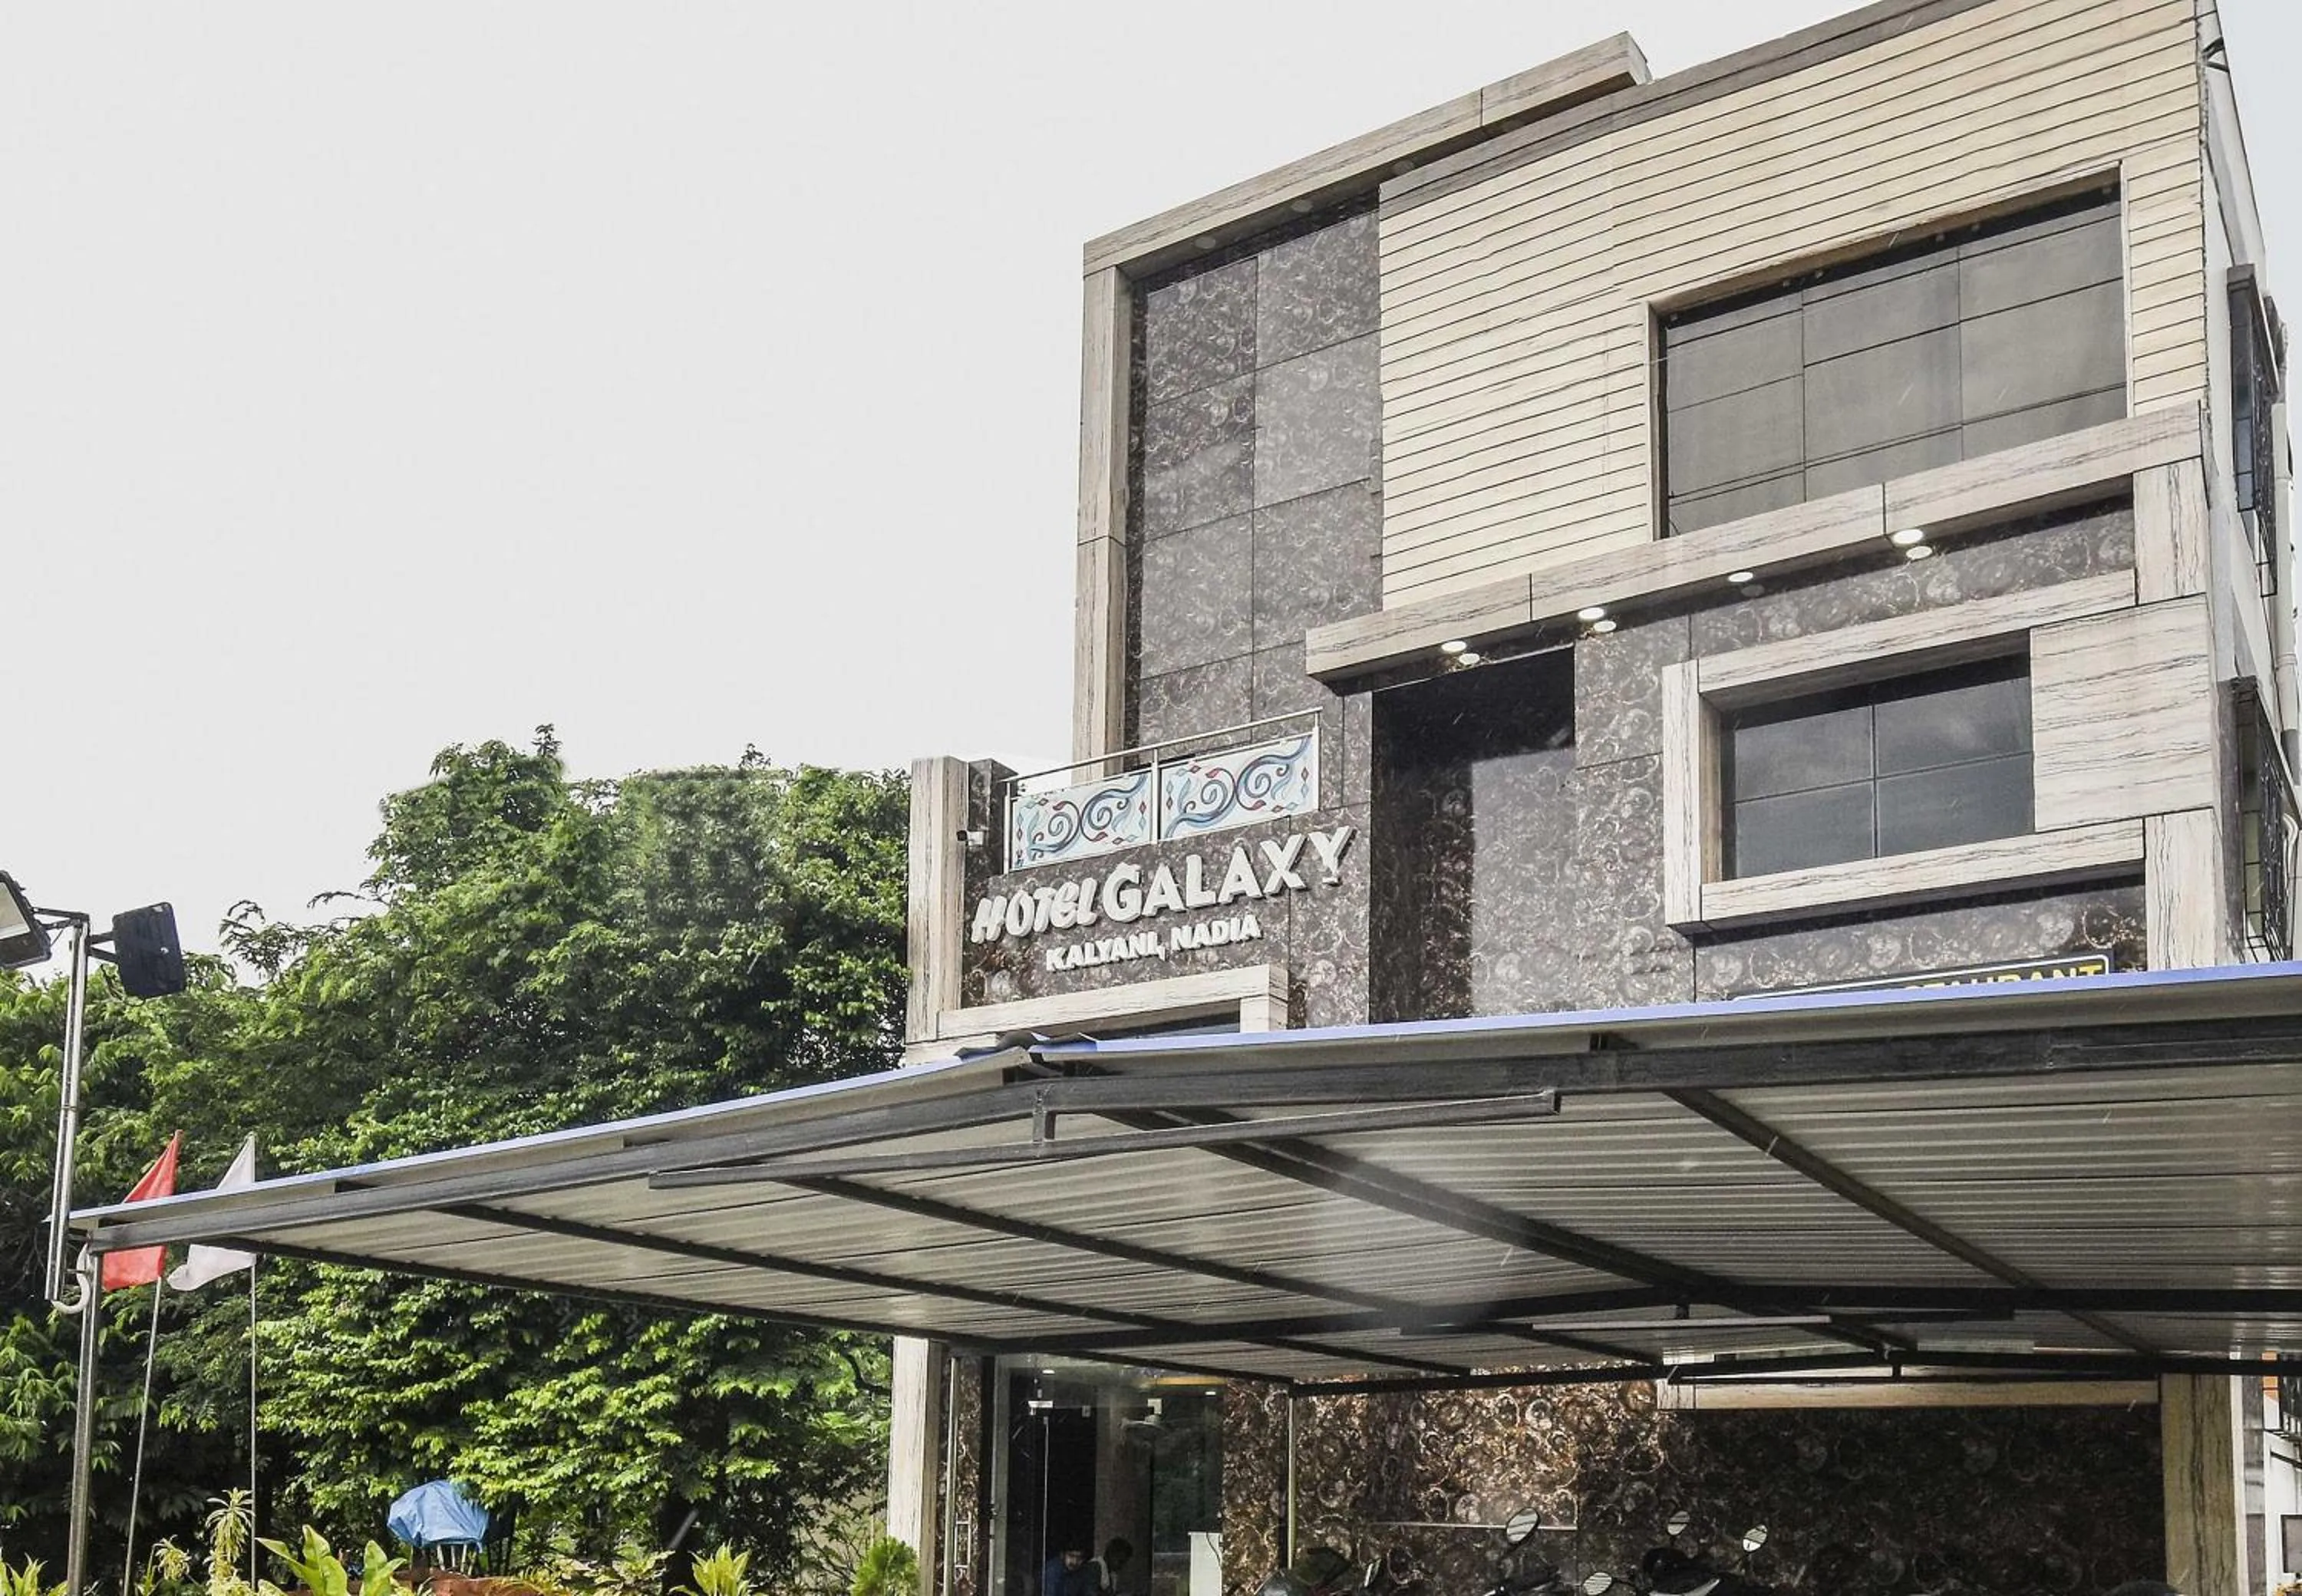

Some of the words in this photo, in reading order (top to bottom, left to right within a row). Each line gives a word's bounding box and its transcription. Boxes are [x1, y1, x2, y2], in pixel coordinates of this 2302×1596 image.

[1103, 826, 1357, 923] GALAXY
[1046, 931, 1166, 973] KALYANI,
[1170, 914, 1264, 952] NADIA
